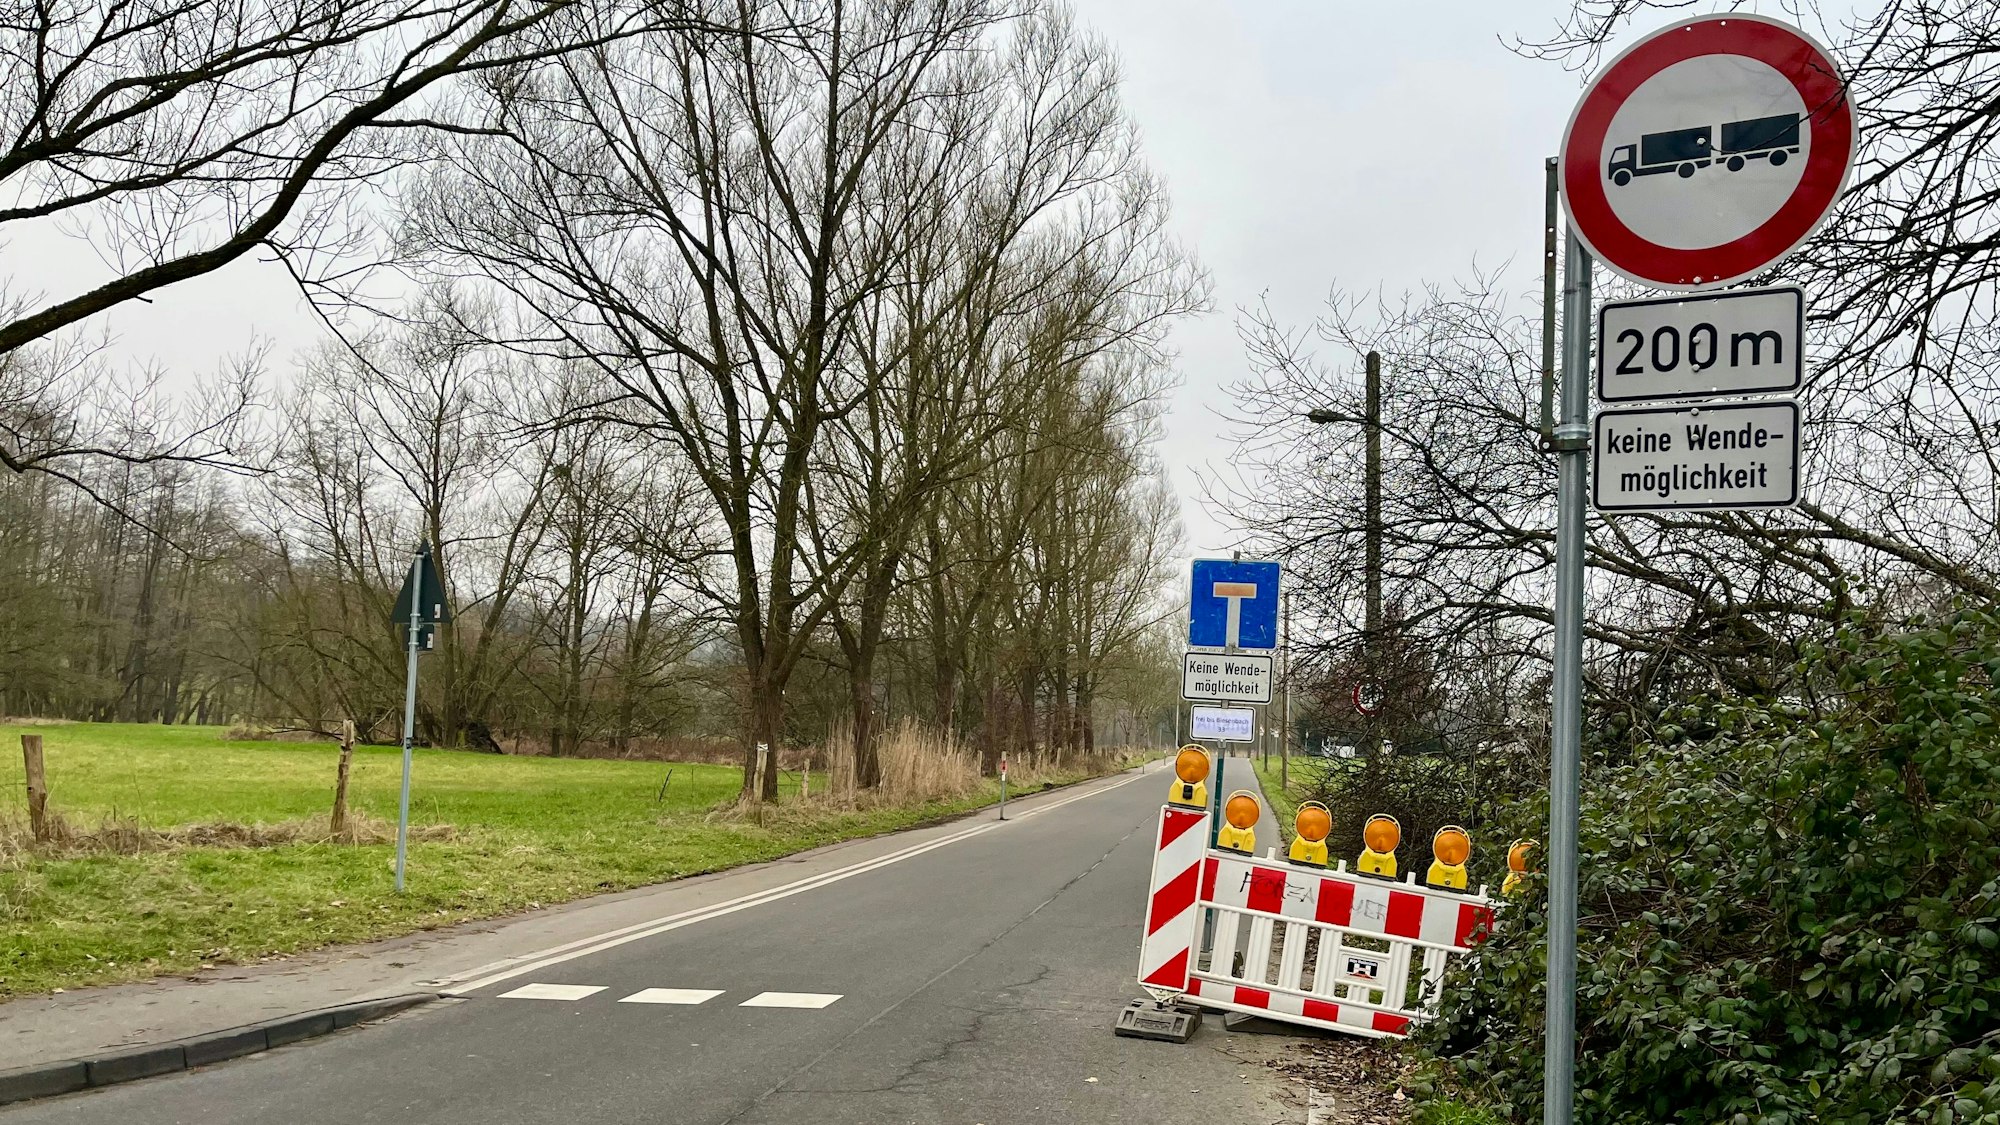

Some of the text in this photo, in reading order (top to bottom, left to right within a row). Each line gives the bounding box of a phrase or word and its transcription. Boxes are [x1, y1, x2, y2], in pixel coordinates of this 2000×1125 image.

[1607, 422, 1784, 454] keine Wende-
[1620, 462, 1768, 498] möglichkeit
[1189, 660, 1267, 676] Keine Wende-
[1195, 679, 1259, 696] möglichkeit
